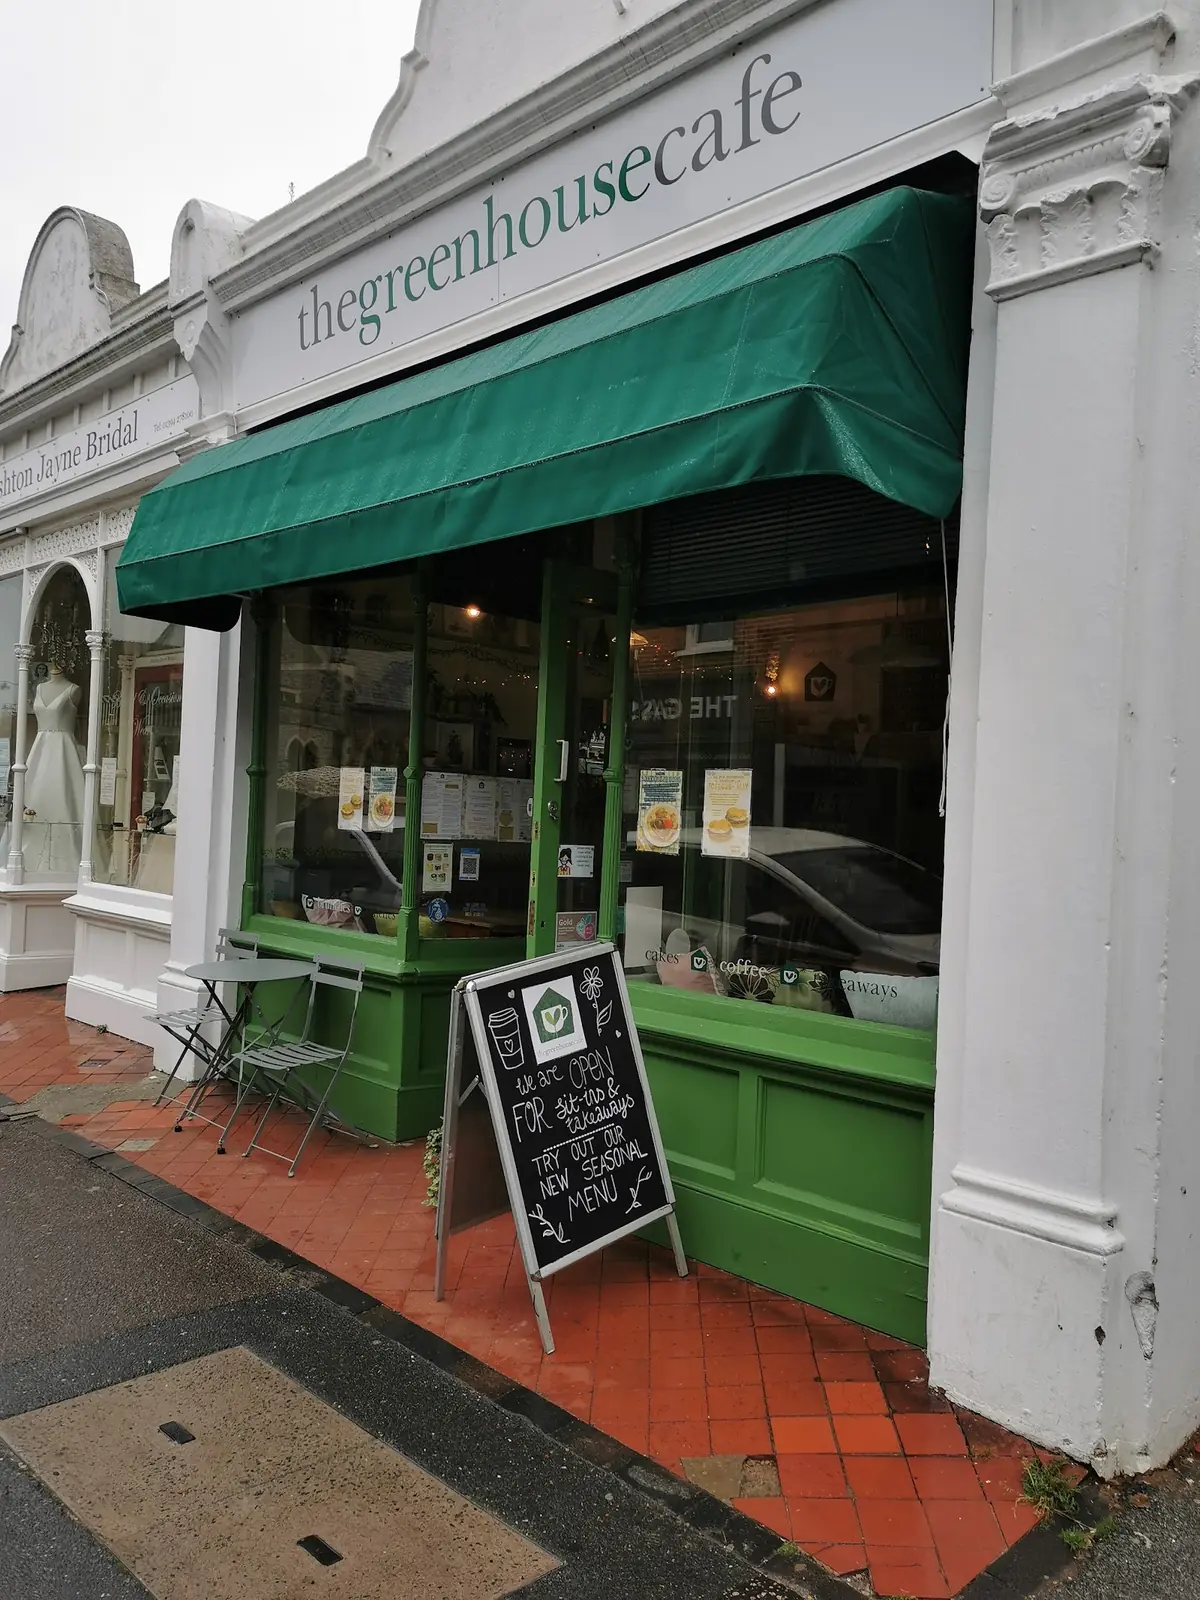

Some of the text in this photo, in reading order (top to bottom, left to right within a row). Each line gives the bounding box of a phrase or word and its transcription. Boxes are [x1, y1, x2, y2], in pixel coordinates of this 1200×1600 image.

[37, 446, 81, 483] Jayne
[86, 410, 138, 462] Bridal
[558, 918, 573, 926] Gold
[644, 947, 680, 965] cakes
[719, 958, 768, 979] coffee
[839, 978, 898, 1003] eaways
[537, 1065, 564, 1087] are
[512, 1096, 554, 1143] FOR
[607, 1077, 621, 1098] &
[565, 1093, 635, 1134] takeaways
[531, 1125, 627, 1177] TRY OUT OUR
[539, 1138, 649, 1200] NEW SEASONAL
[568, 1174, 618, 1222] MENU
